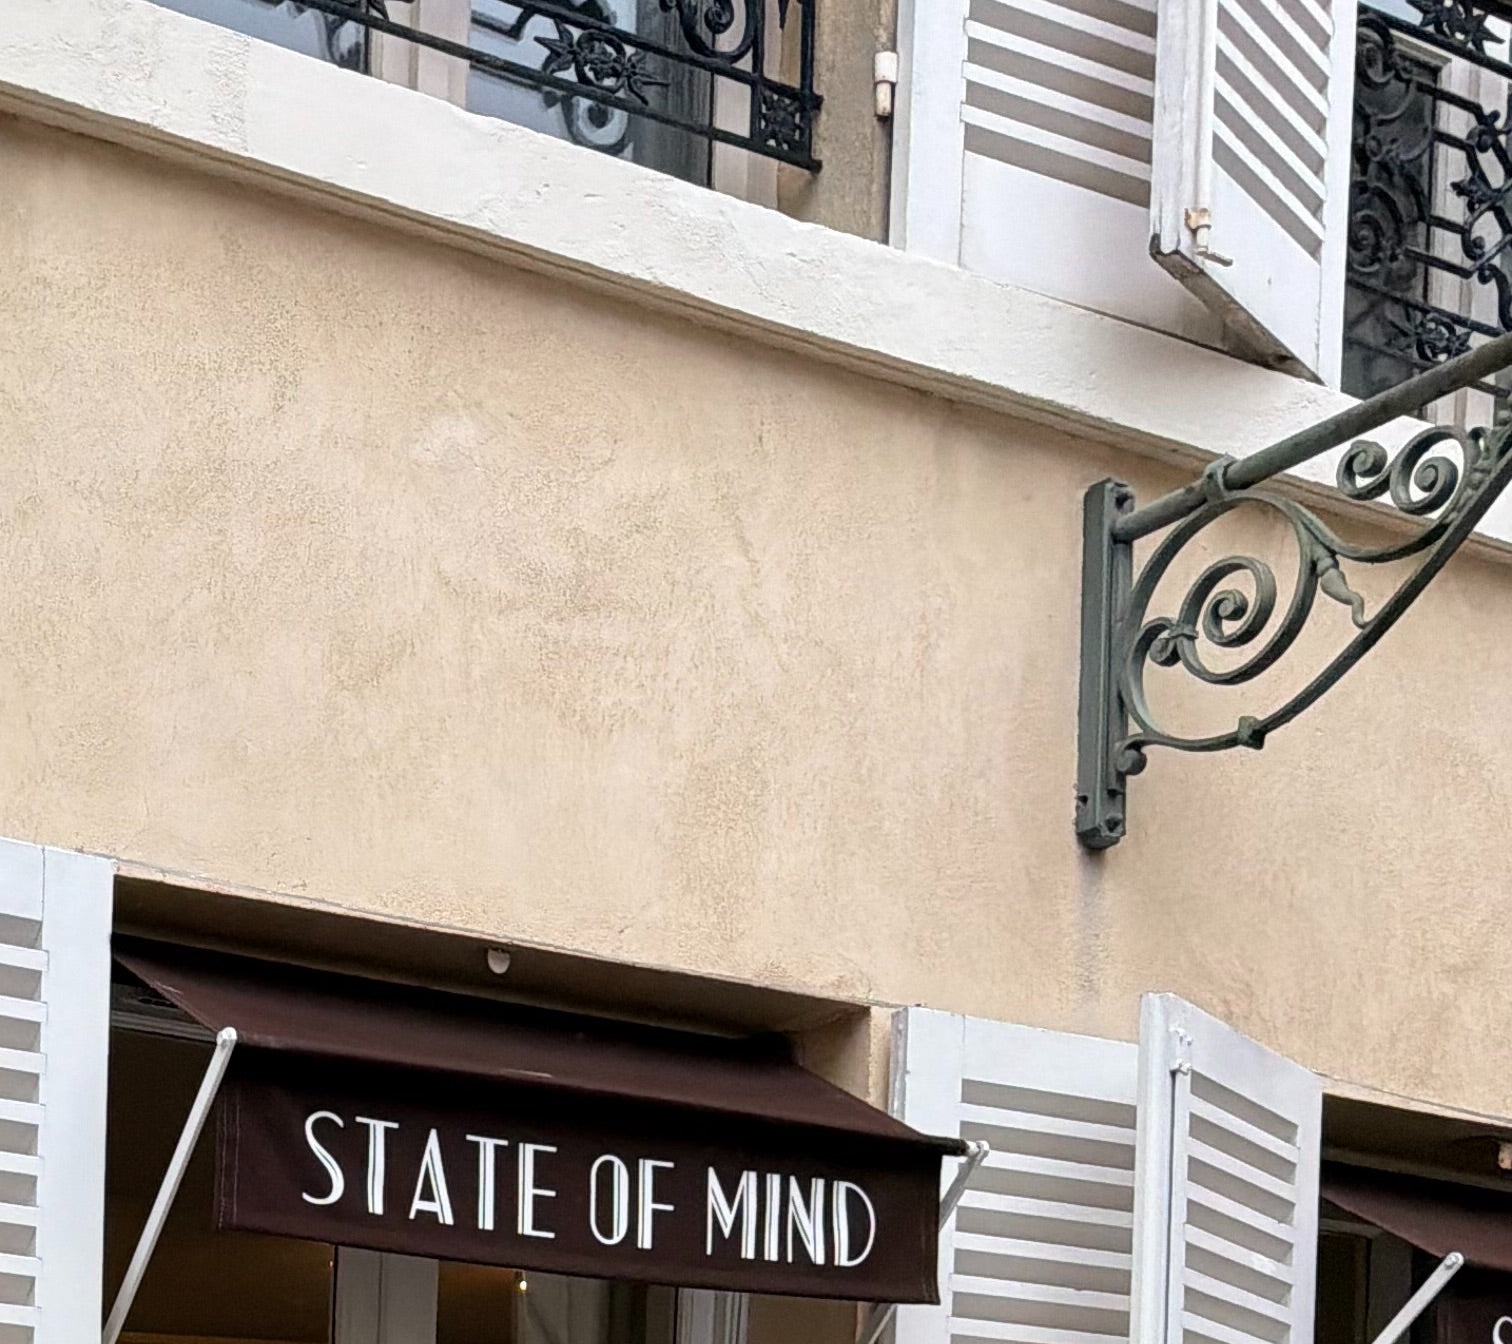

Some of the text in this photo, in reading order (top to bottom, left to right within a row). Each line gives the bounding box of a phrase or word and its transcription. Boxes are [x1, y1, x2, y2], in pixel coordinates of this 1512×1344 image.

[301, 1110, 876, 1268] STATE OF MIND
